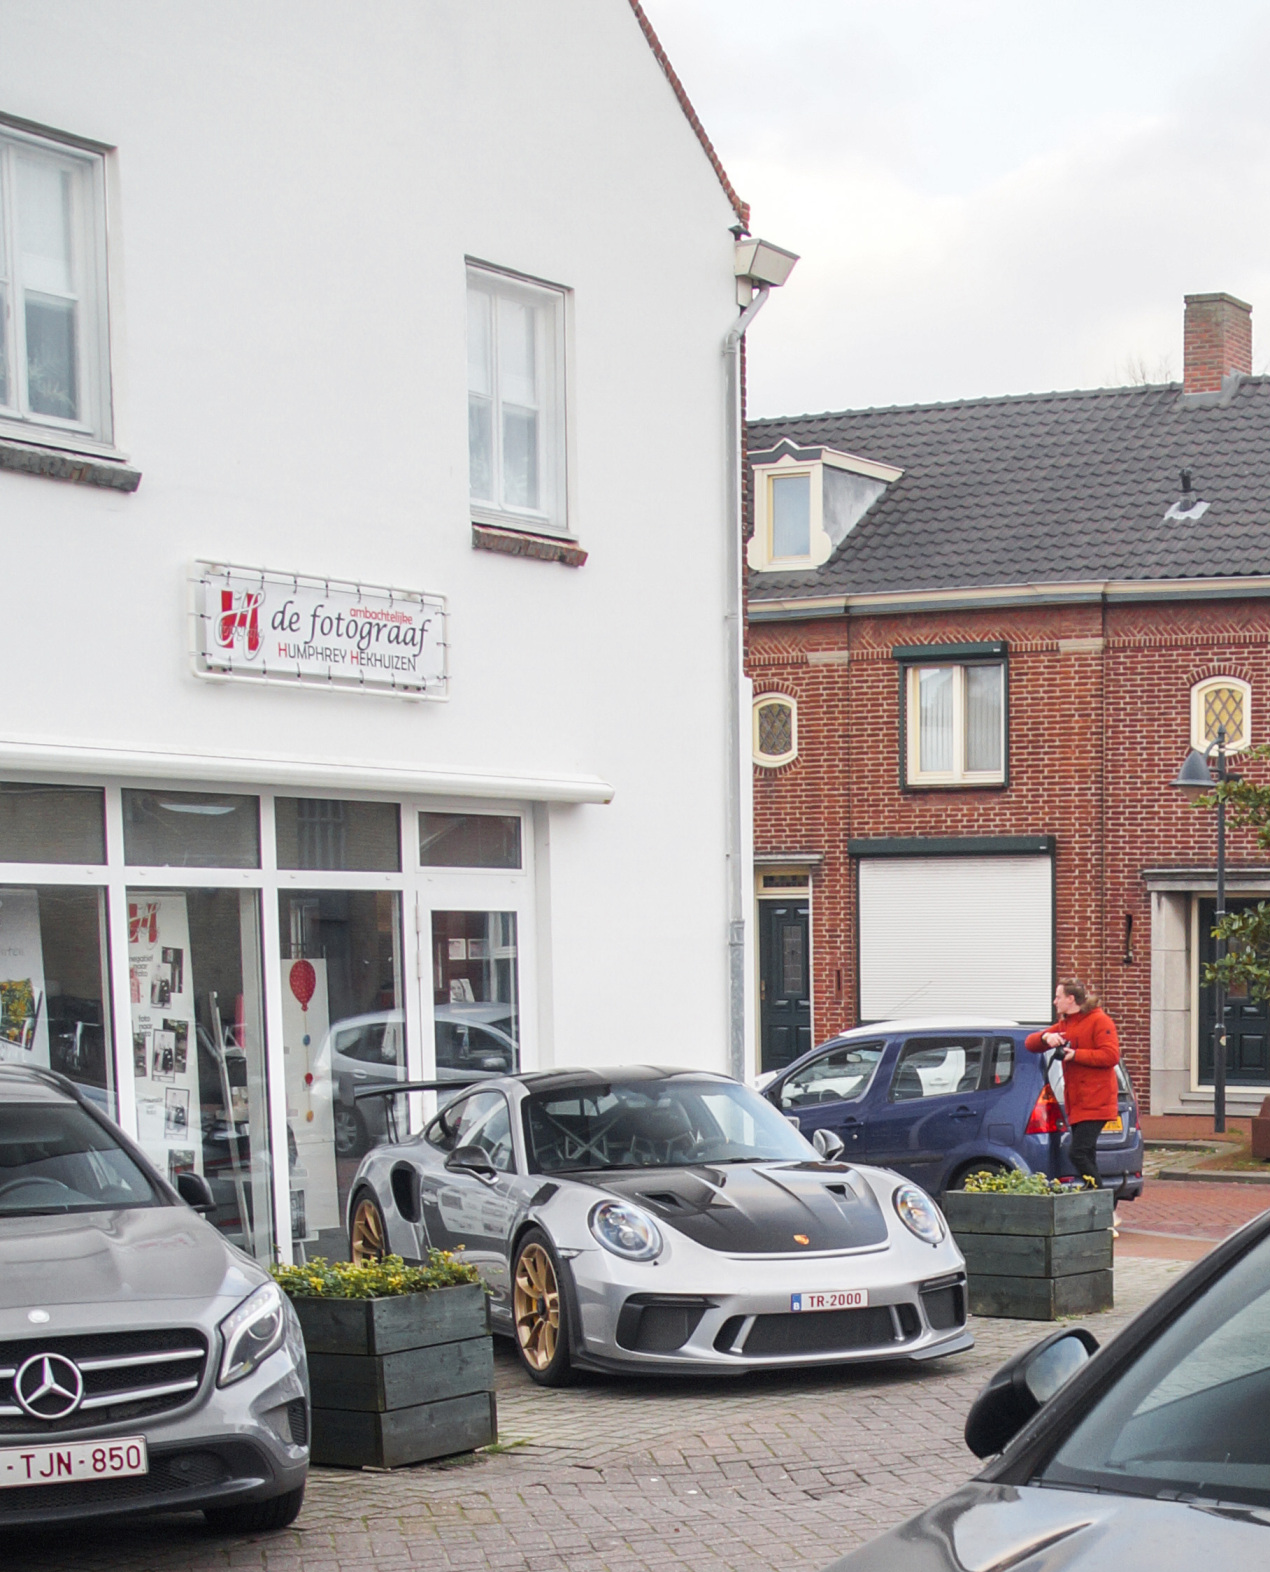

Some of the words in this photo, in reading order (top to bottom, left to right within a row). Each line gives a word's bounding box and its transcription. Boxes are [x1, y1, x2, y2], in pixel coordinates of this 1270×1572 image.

[350, 606, 413, 625] ambachtelijke
[271, 600, 301, 632] de
[303, 604, 432, 658] fotograaf
[278, 642, 347, 663] HUMPHREY
[350, 649, 416, 671] HEKHUIZEN
[808, 1292, 862, 1308] TR-2000
